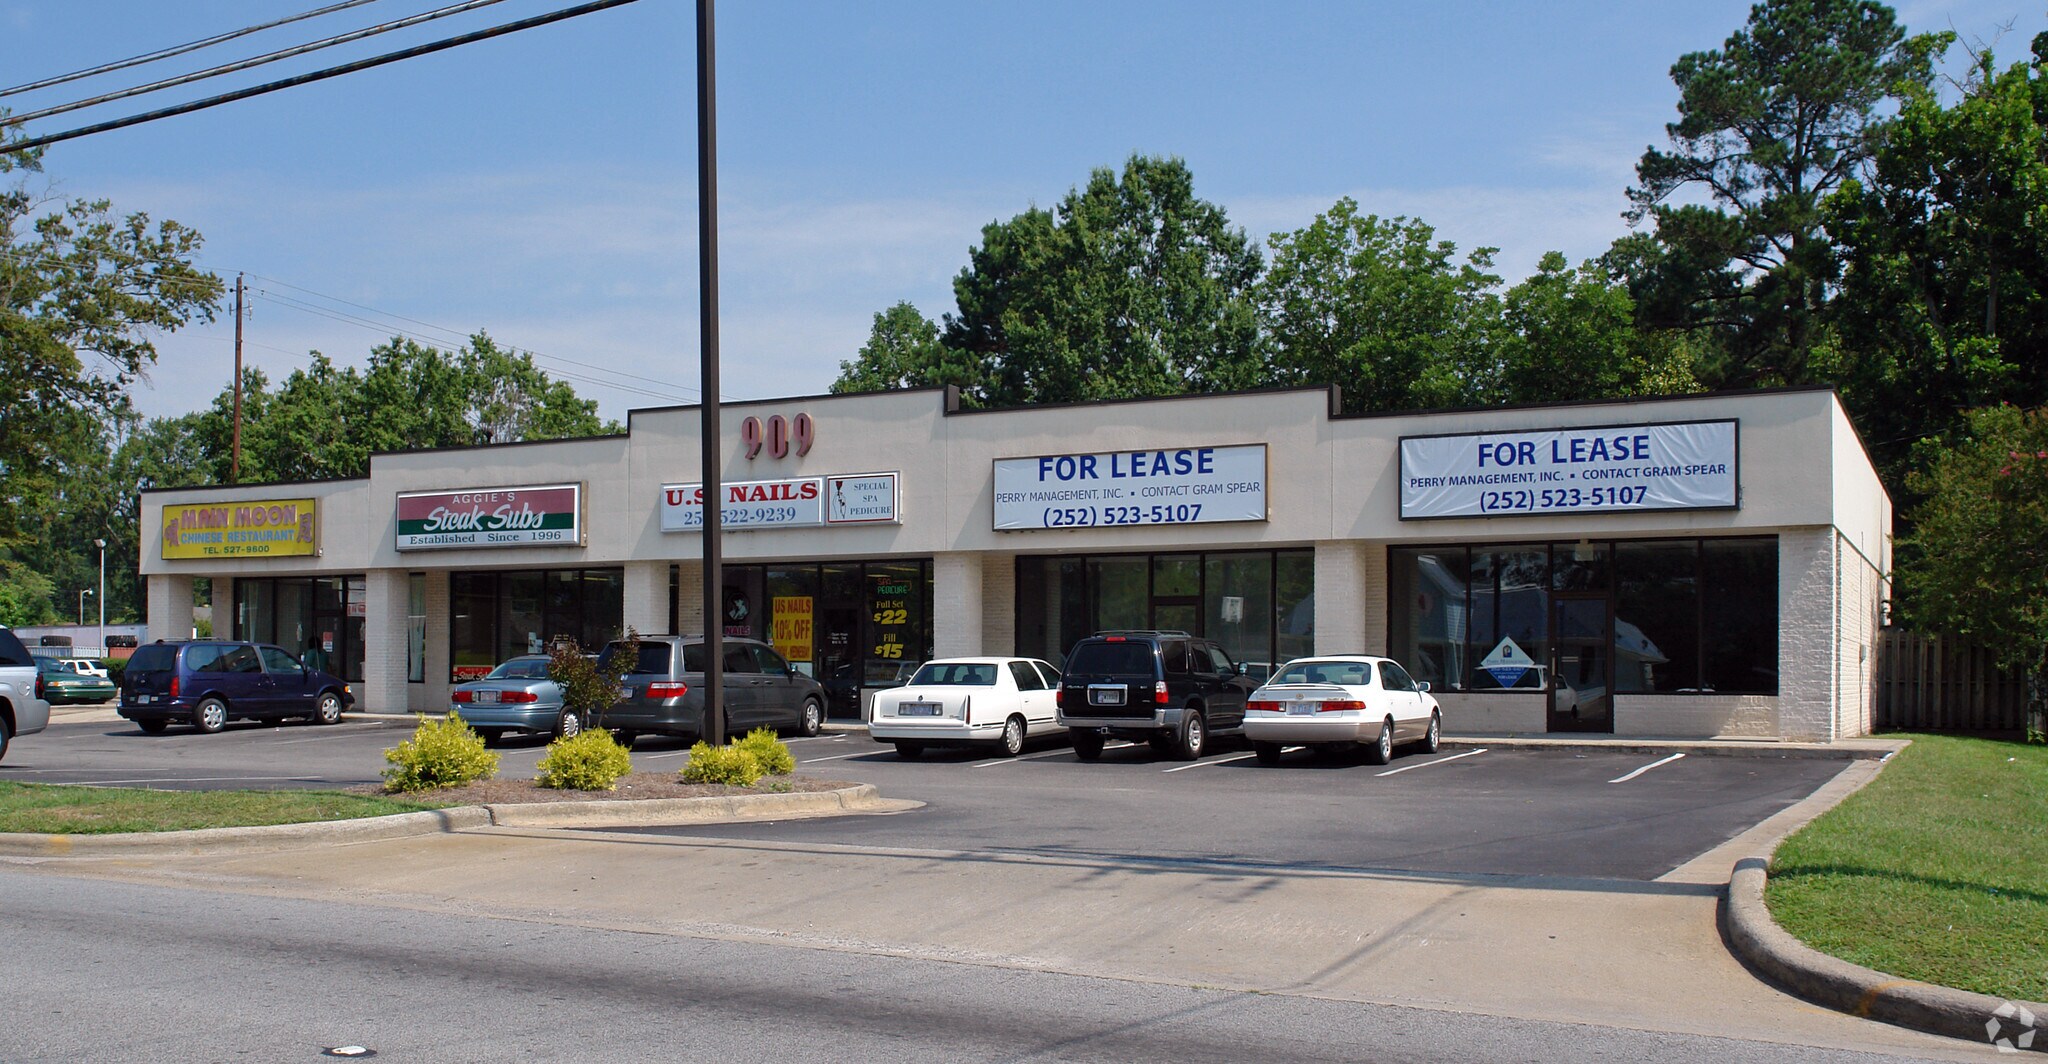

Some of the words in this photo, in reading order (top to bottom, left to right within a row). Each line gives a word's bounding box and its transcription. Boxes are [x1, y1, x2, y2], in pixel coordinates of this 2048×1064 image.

[741, 412, 815, 460] 909
[1479, 441, 1536, 468] FOR
[1552, 435, 1649, 464] LEASE
[1038, 455, 1099, 482] FOR
[1111, 448, 1214, 479] LEASE
[1410, 476, 1446, 488] PERRY
[1448, 471, 1537, 487] MANAGEMENT,
[1540, 470, 1564, 482] INC.
[1582, 466, 1640, 480] CONTACT
[1643, 464, 1682, 477] GRAM
[1684, 463, 1726, 476] SPEAR
[729, 482, 818, 503] NAILS
[853, 481, 888, 491] SPECIAL
[996, 491, 1027, 503] PERRY
[1029, 489, 1100, 502] MANAGEMENT,
[1103, 488, 1124, 499] INC.
[1141, 485, 1191, 498] CONTACT
[1192, 483, 1223, 495] GRAM
[1226, 481, 1261, 493] SPEAR
[452, 492, 516, 504] AGGIE'S
[862, 494, 878, 503] SPA
[1479, 489, 1535, 513] (252)
[1540, 485, 1648, 509] 523-5107
[181, 508, 229, 530] MAIN
[234, 504, 297, 527] MOON
[423, 505, 485, 532] Steak
[487, 502, 546, 529] Subs
[850, 506, 892, 515] PEDICURE
[1043, 506, 1097, 528] (252)
[1104, 504, 1202, 525] 523-5107
[180, 532, 223, 544] CHINESE
[227, 529, 295, 543] RESTAURANT
[410, 533, 476, 545] Established
[488, 532, 519, 542] Since
[531, 531, 561, 541] 1996
[877, 585, 908, 595] PEDICURE
[775, 599, 785, 614] US
[788, 599, 811, 614] NAILS
[876, 600, 890, 609] Full
[891, 600, 904, 609] Set
[873, 609, 908, 625] $22
[725, 625, 751, 636] NAILS
[775, 619, 792, 641] 10%
[794, 619, 810, 640] OFF
[883, 633, 896, 643] Fill
[874, 643, 904, 659] $15
